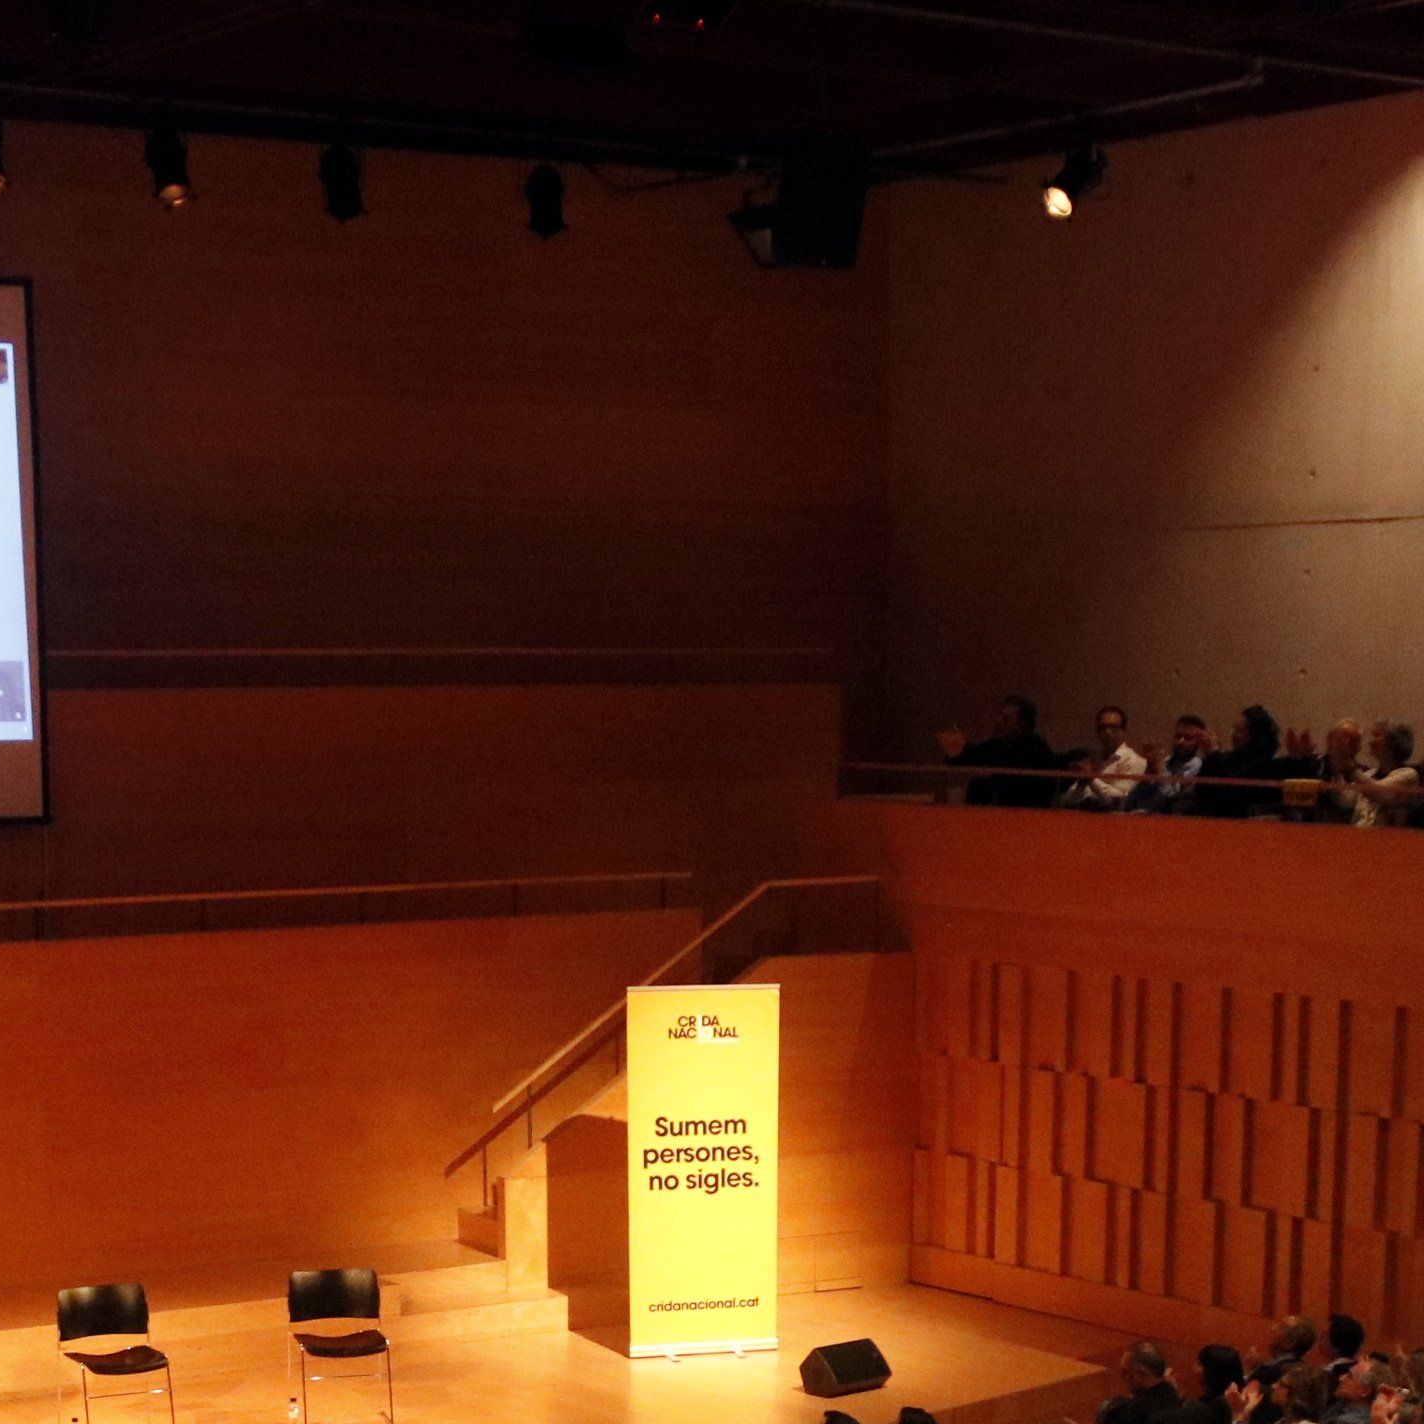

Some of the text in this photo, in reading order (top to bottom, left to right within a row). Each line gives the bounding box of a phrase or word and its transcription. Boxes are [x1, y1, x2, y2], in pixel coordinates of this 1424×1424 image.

[655, 1116, 746, 1137] Sumem
[643, 1145, 759, 1169] persones,
[649, 1168, 759, 1195] no sigles.
[648, 1297, 759, 1313] cridanacional.cat
